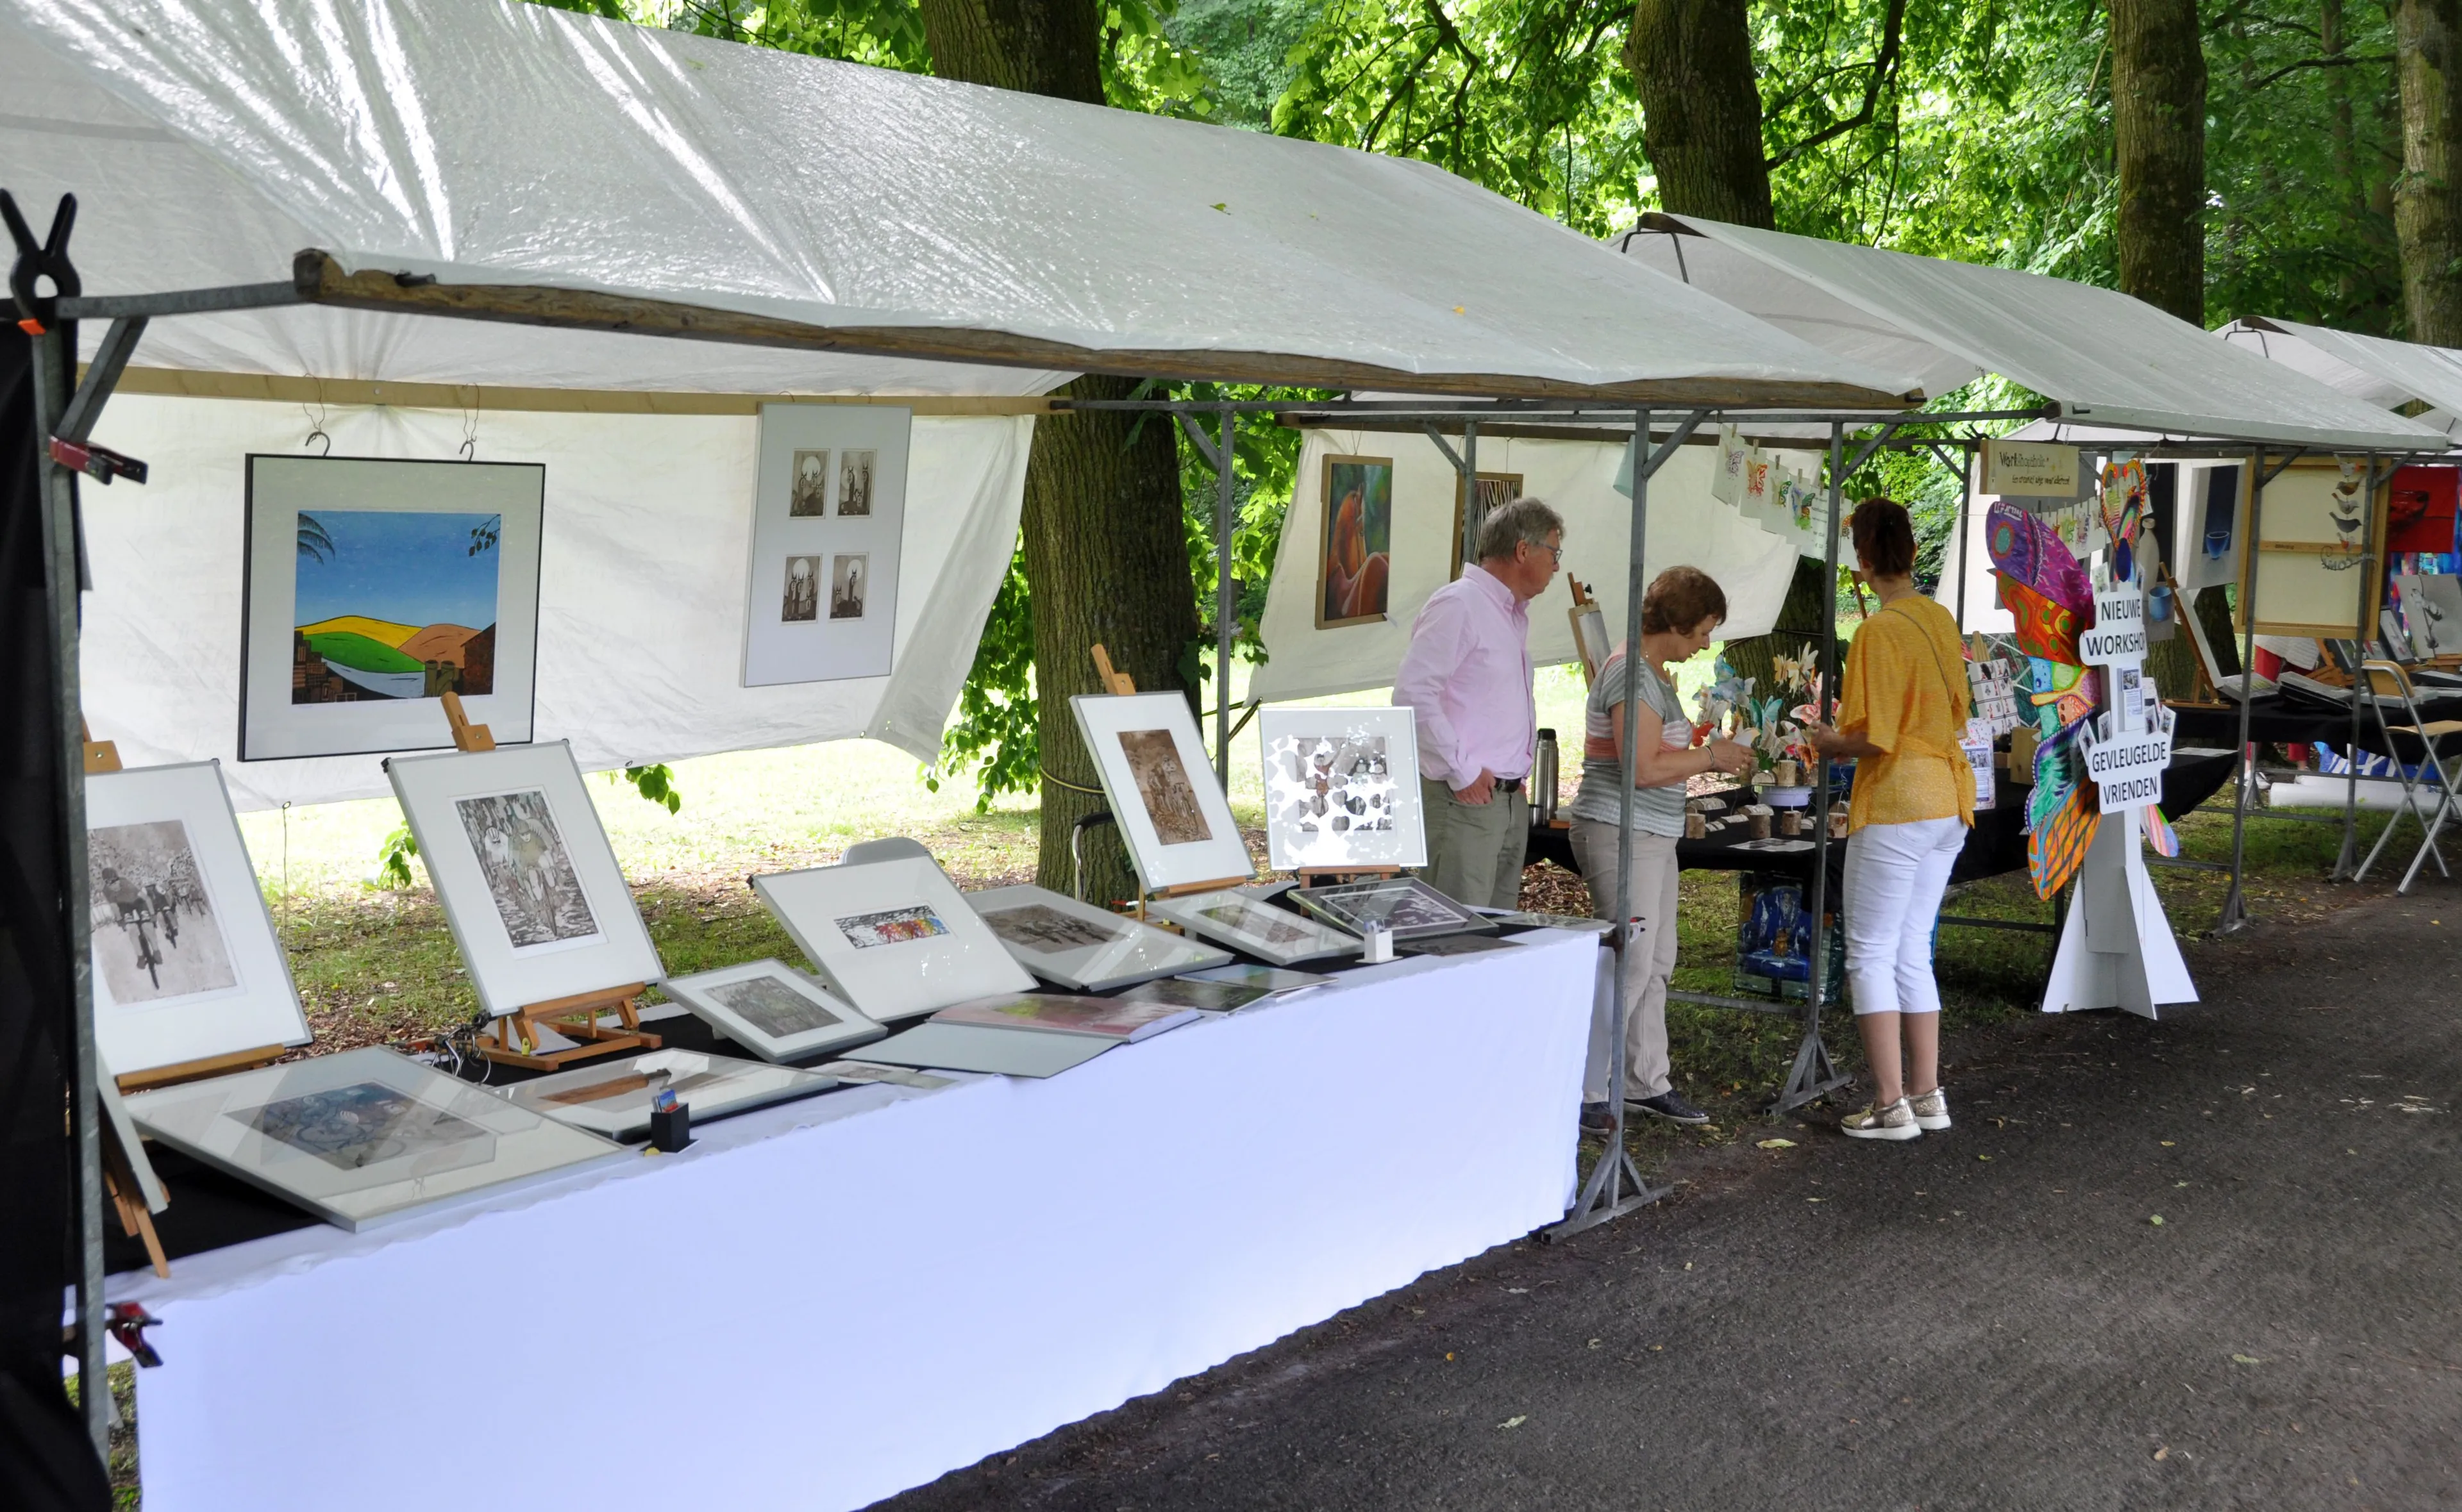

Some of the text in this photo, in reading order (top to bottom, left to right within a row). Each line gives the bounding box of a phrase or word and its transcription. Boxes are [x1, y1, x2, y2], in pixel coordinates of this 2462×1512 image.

[2101, 599, 2141, 620] NIEUWE
[2092, 742, 2166, 772] GEVLEUGELDE
[2103, 776, 2157, 804] VRIENDEN
